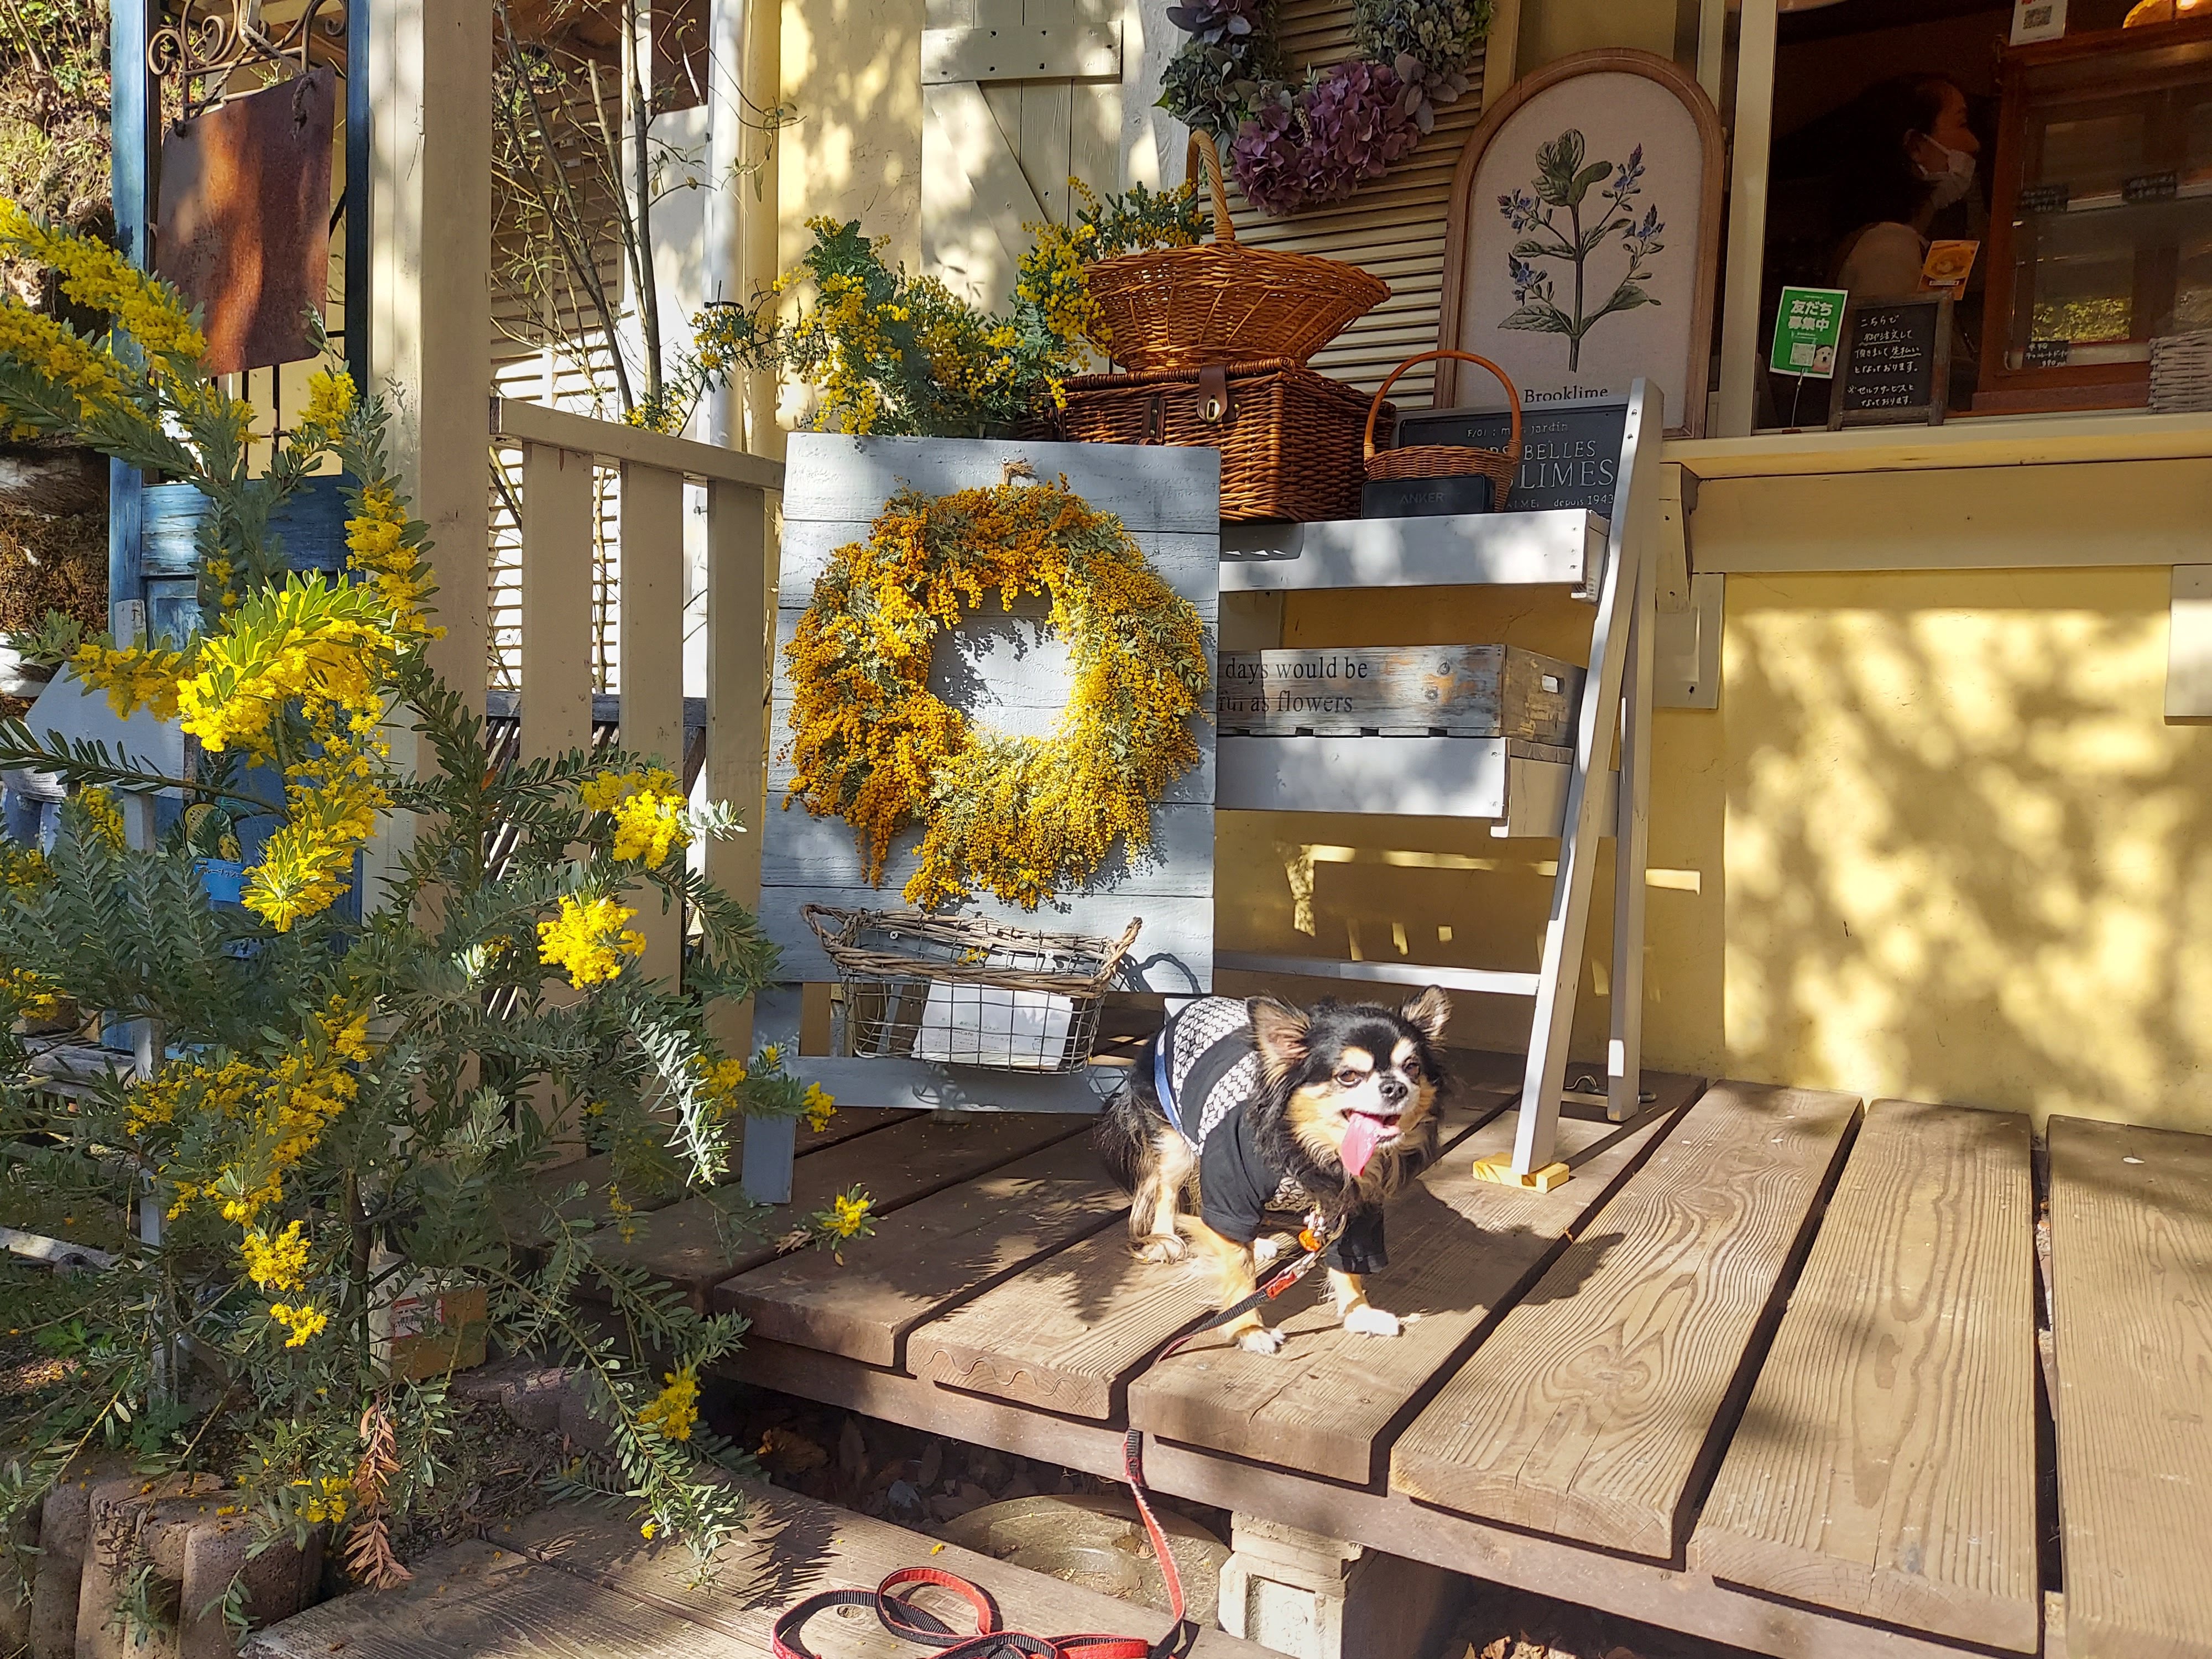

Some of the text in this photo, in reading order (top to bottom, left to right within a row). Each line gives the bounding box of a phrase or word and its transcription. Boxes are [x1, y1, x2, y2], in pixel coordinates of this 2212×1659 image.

[1791, 300, 1833, 316] 友だち
[1788, 316, 1830, 332] 募集中
[1860, 314, 1901, 328] こちらで
[1524, 385, 1608, 403] Brooklime
[1531, 422, 1568, 436] jardin
[1524, 441, 1596, 461] BELLES
[1510, 458, 1614, 489] LIMES
[1400, 492, 1445, 504] ANKER
[1554, 499, 1584, 508] depuis
[1587, 494, 1614, 505] 1943
[1225, 656, 1368, 685] days would be
[1251, 696, 1270, 712] as
[1276, 690, 1353, 713] flowers
